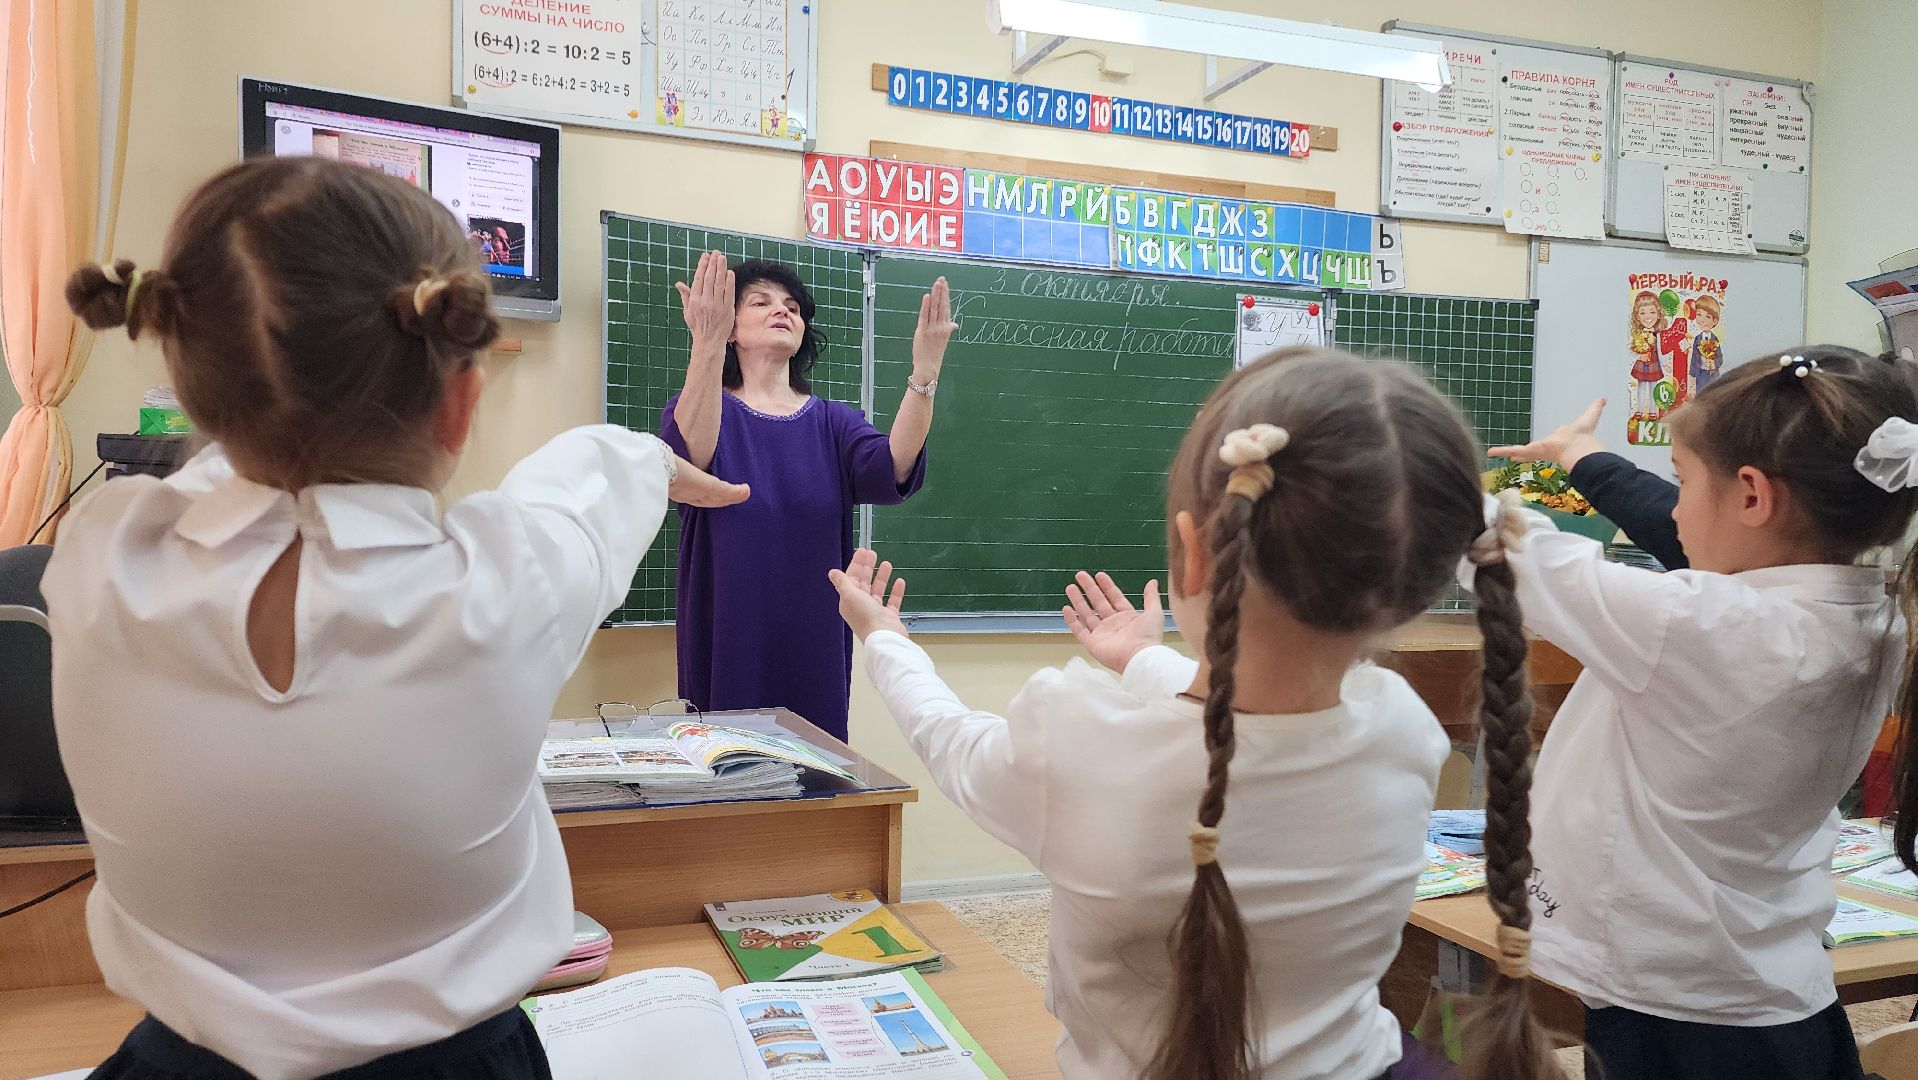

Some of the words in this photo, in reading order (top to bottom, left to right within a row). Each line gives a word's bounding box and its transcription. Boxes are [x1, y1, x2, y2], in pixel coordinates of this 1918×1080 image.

[479, 3, 542, 24] СУММЫ
[546, 14, 568, 28] НА
[572, 17, 625, 34] ЧИСЛО
[621, 50, 631, 66] 5
[1452, 52, 1481, 64] РЕЧИ
[623, 84, 630, 97] 5
[1511, 70, 1560, 84] ПРАВИЛА
[1562, 75, 1596, 88] КОРНЯ
[893, 72, 907, 101] 0
[915, 76, 926, 103] 1
[935, 78, 948, 106] 2
[956, 81, 968, 108] 3
[976, 84, 989, 111] 4
[996, 87, 1009, 114] 5
[1016, 89, 1029, 117] 6
[1037, 92, 1049, 119] 7
[1055, 95, 1068, 122] 8
[1075, 97, 1087, 124] 9
[1092, 100, 1110, 128] 10
[1112, 102, 1129, 129] 11
[1133, 105, 1152, 131] 12
[1155, 108, 1172, 134] 13
[1175, 111, 1193, 138] 14
[1195, 113, 1213, 140] 15
[1215, 116, 1232, 143] 16
[1234, 119, 1252, 145] 17
[1254, 121, 1271, 148] 18
[1273, 124, 1291, 150] 19
[1290, 128, 1310, 153] 20
[1399, 122, 1427, 131] АЗБОР
[1429, 124, 1489, 138] ПРЕДЛОЖЕНИЯ
[806, 158, 834, 193] А
[839, 161, 868, 196] О
[874, 163, 898, 198] У
[906, 168, 932, 203] Ы
[939, 172, 959, 206] Э
[967, 174, 990, 209] Н
[994, 178, 1022, 213] М
[1026, 182, 1049, 216] Л
[1059, 185, 1077, 218] Р
[1085, 187, 1109, 222] Й
[810, 202, 829, 236] Я
[844, 201, 862, 239] Ё
[871, 209, 900, 244] Ю
[904, 211, 928, 246] И
[939, 215, 957, 248] Е
[1114, 195, 1132, 226] Б
[1143, 197, 1159, 228] В
[1170, 200, 1187, 231] Г
[1193, 203, 1216, 237] Д
[1219, 205, 1245, 237] Ж
[1251, 208, 1269, 239] З
[1379, 223, 1395, 250] Ь
[1137, 237, 1160, 267] Ф
[1168, 239, 1188, 270] К
[1196, 243, 1216, 271] Т
[1219, 243, 1244, 274] Ш
[1250, 247, 1268, 277] С
[1277, 248, 1296, 280] Х
[1302, 251, 1319, 284] Ц
[1325, 254, 1342, 283] Ч
[1347, 257, 1373, 289] Щ
[1377, 260, 1397, 284] Ъ
[989, 268, 1007, 293] 3
[1699, 277, 1728, 293] РА
[949, 290, 1114, 351] Классная
[1113, 318, 1235, 371] работа
[727, 906, 864, 923] Окружающий
[850, 925, 923, 958] 1
